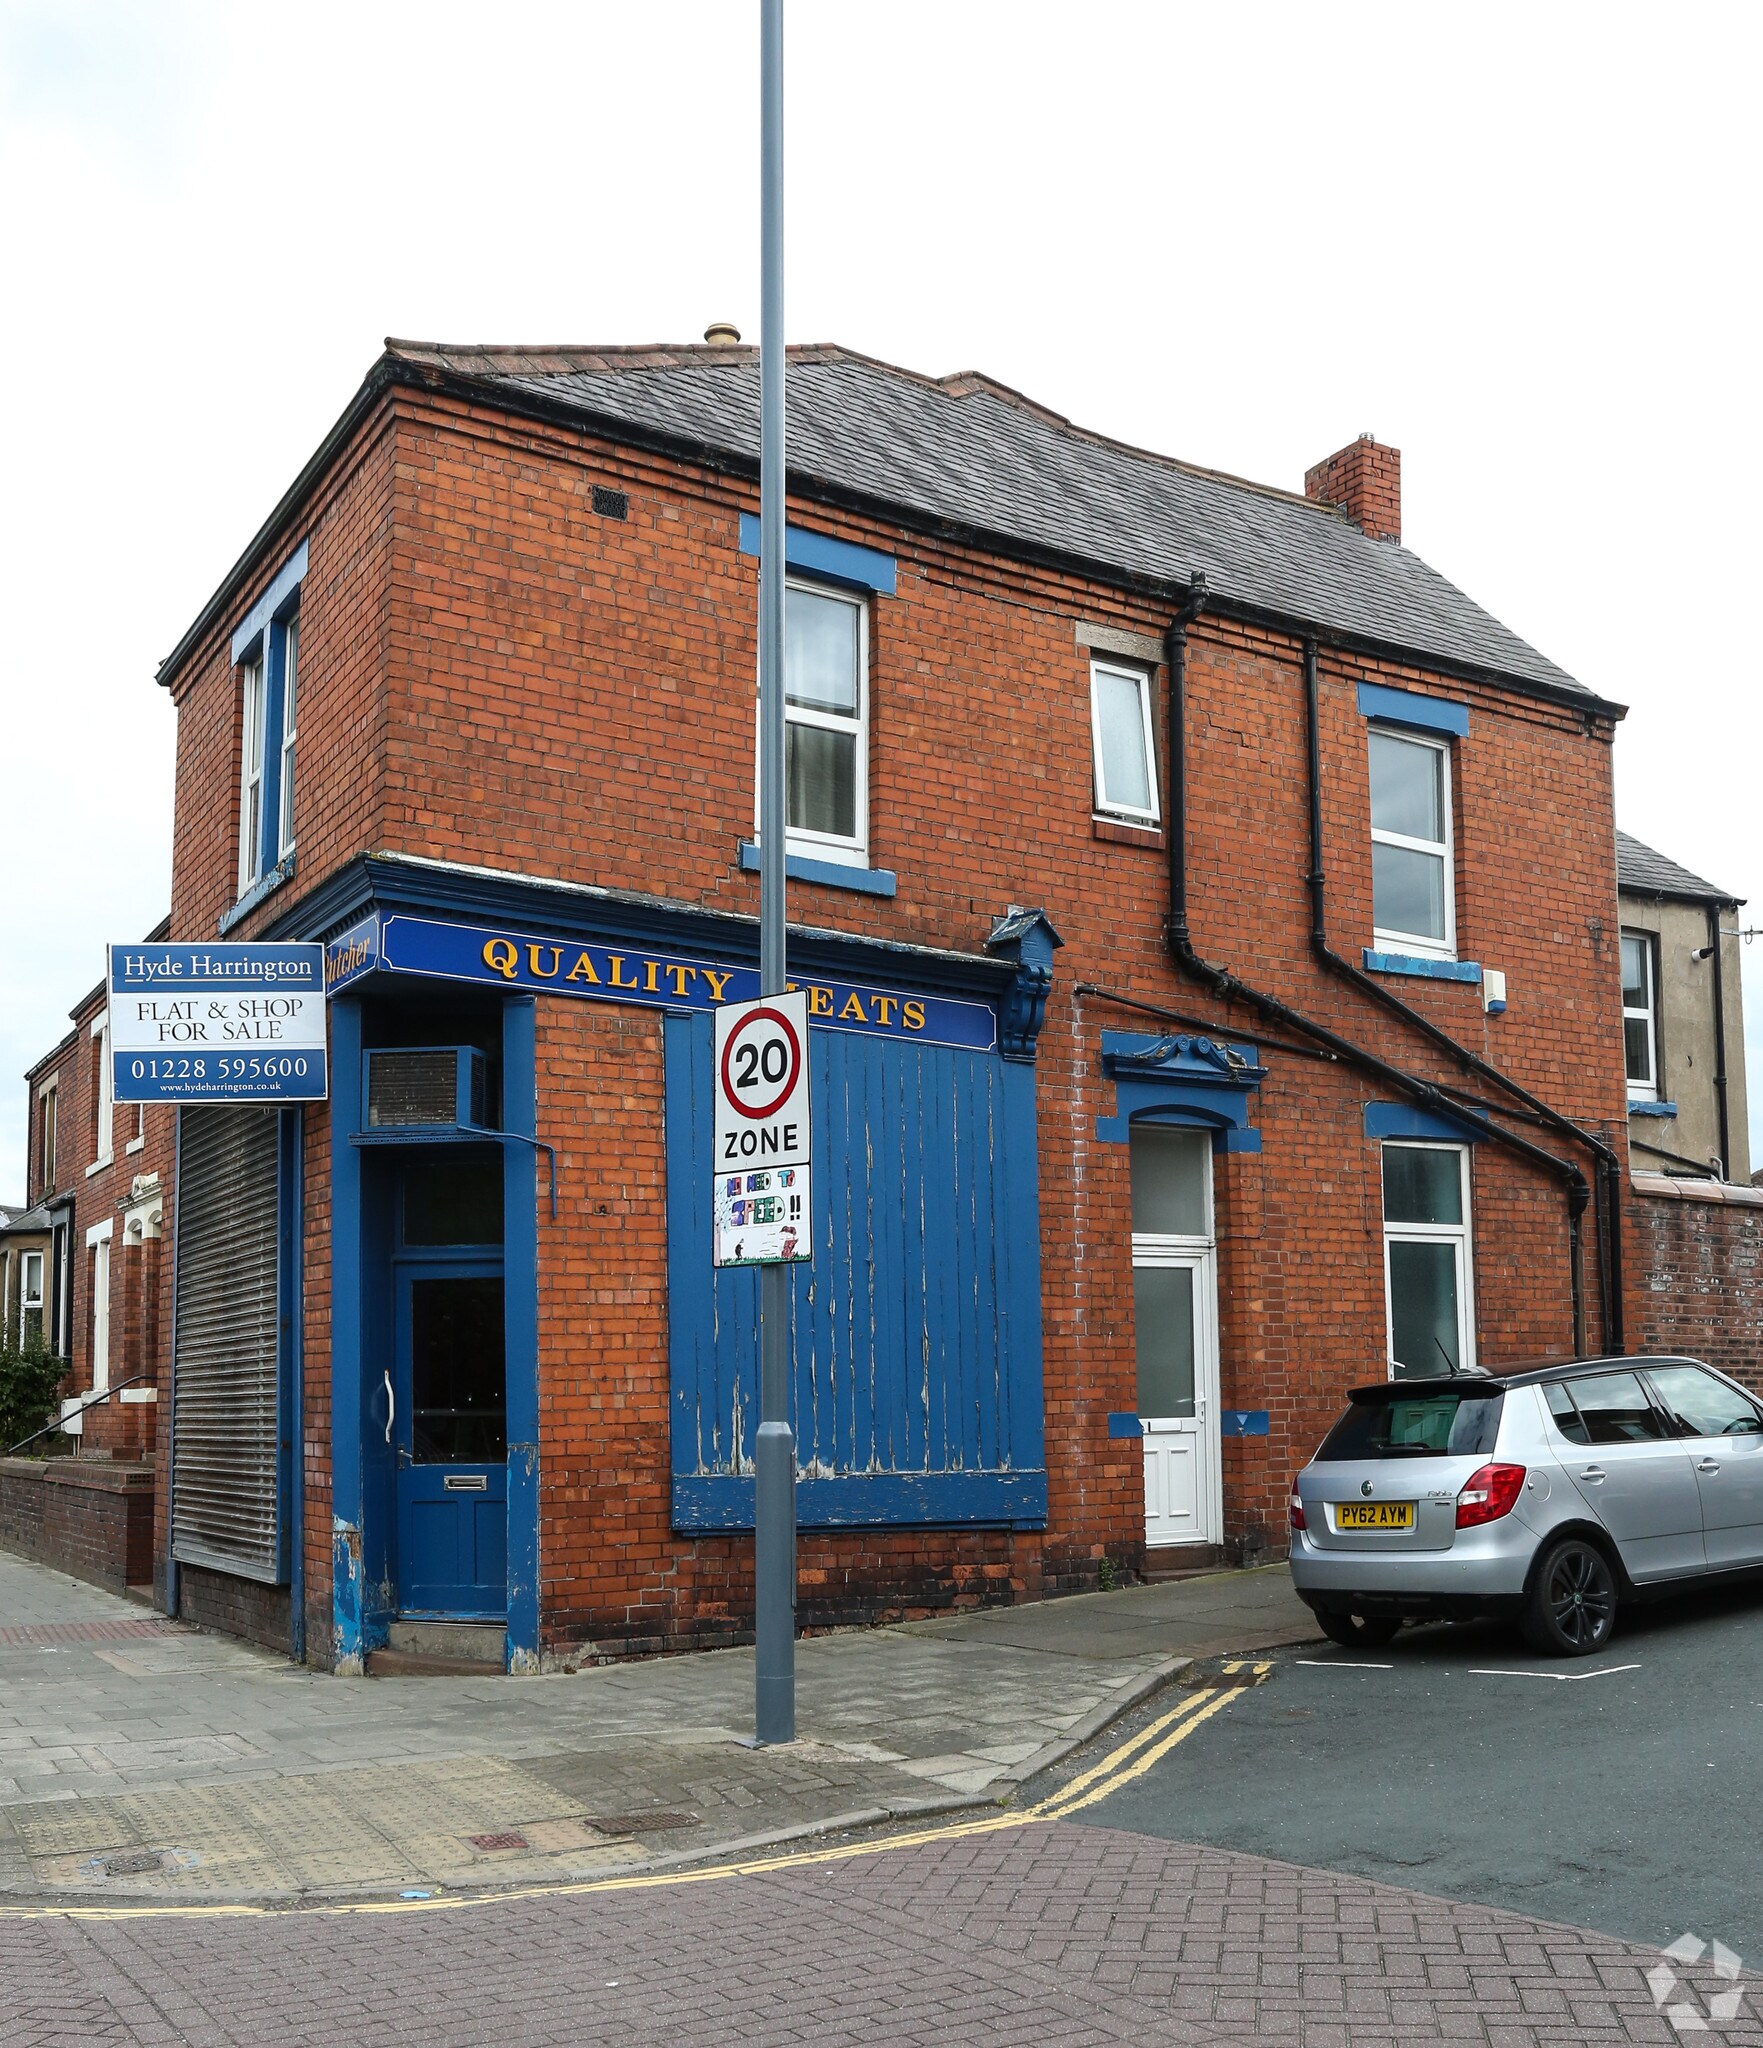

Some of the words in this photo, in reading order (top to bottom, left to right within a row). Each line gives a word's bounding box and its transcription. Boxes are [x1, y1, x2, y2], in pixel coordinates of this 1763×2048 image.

[124, 955, 183, 982] Hyde
[190, 955, 312, 982] Harrington
[482, 938, 734, 1002] QUALITY
[785, 982, 926, 1030] EATS
[137, 1001, 199, 1021] FLAT
[208, 1001, 229, 1019] &
[238, 999, 303, 1018] SHOP
[158, 1022, 209, 1042] FOR
[222, 1021, 283, 1040] SALE
[131, 1059, 206, 1079] 01228
[218, 1057, 308, 1079] 595600
[735, 1038, 788, 1089] 20
[159, 1081, 281, 1092] www.hydeharrington.co.uk
[724, 1123, 798, 1159] ZONE
[746, 1172, 771, 1193] NEED
[777, 1169, 796, 1188] TO
[1342, 1507, 1375, 1524] PY62
[1380, 1506, 1406, 1523] AYM
